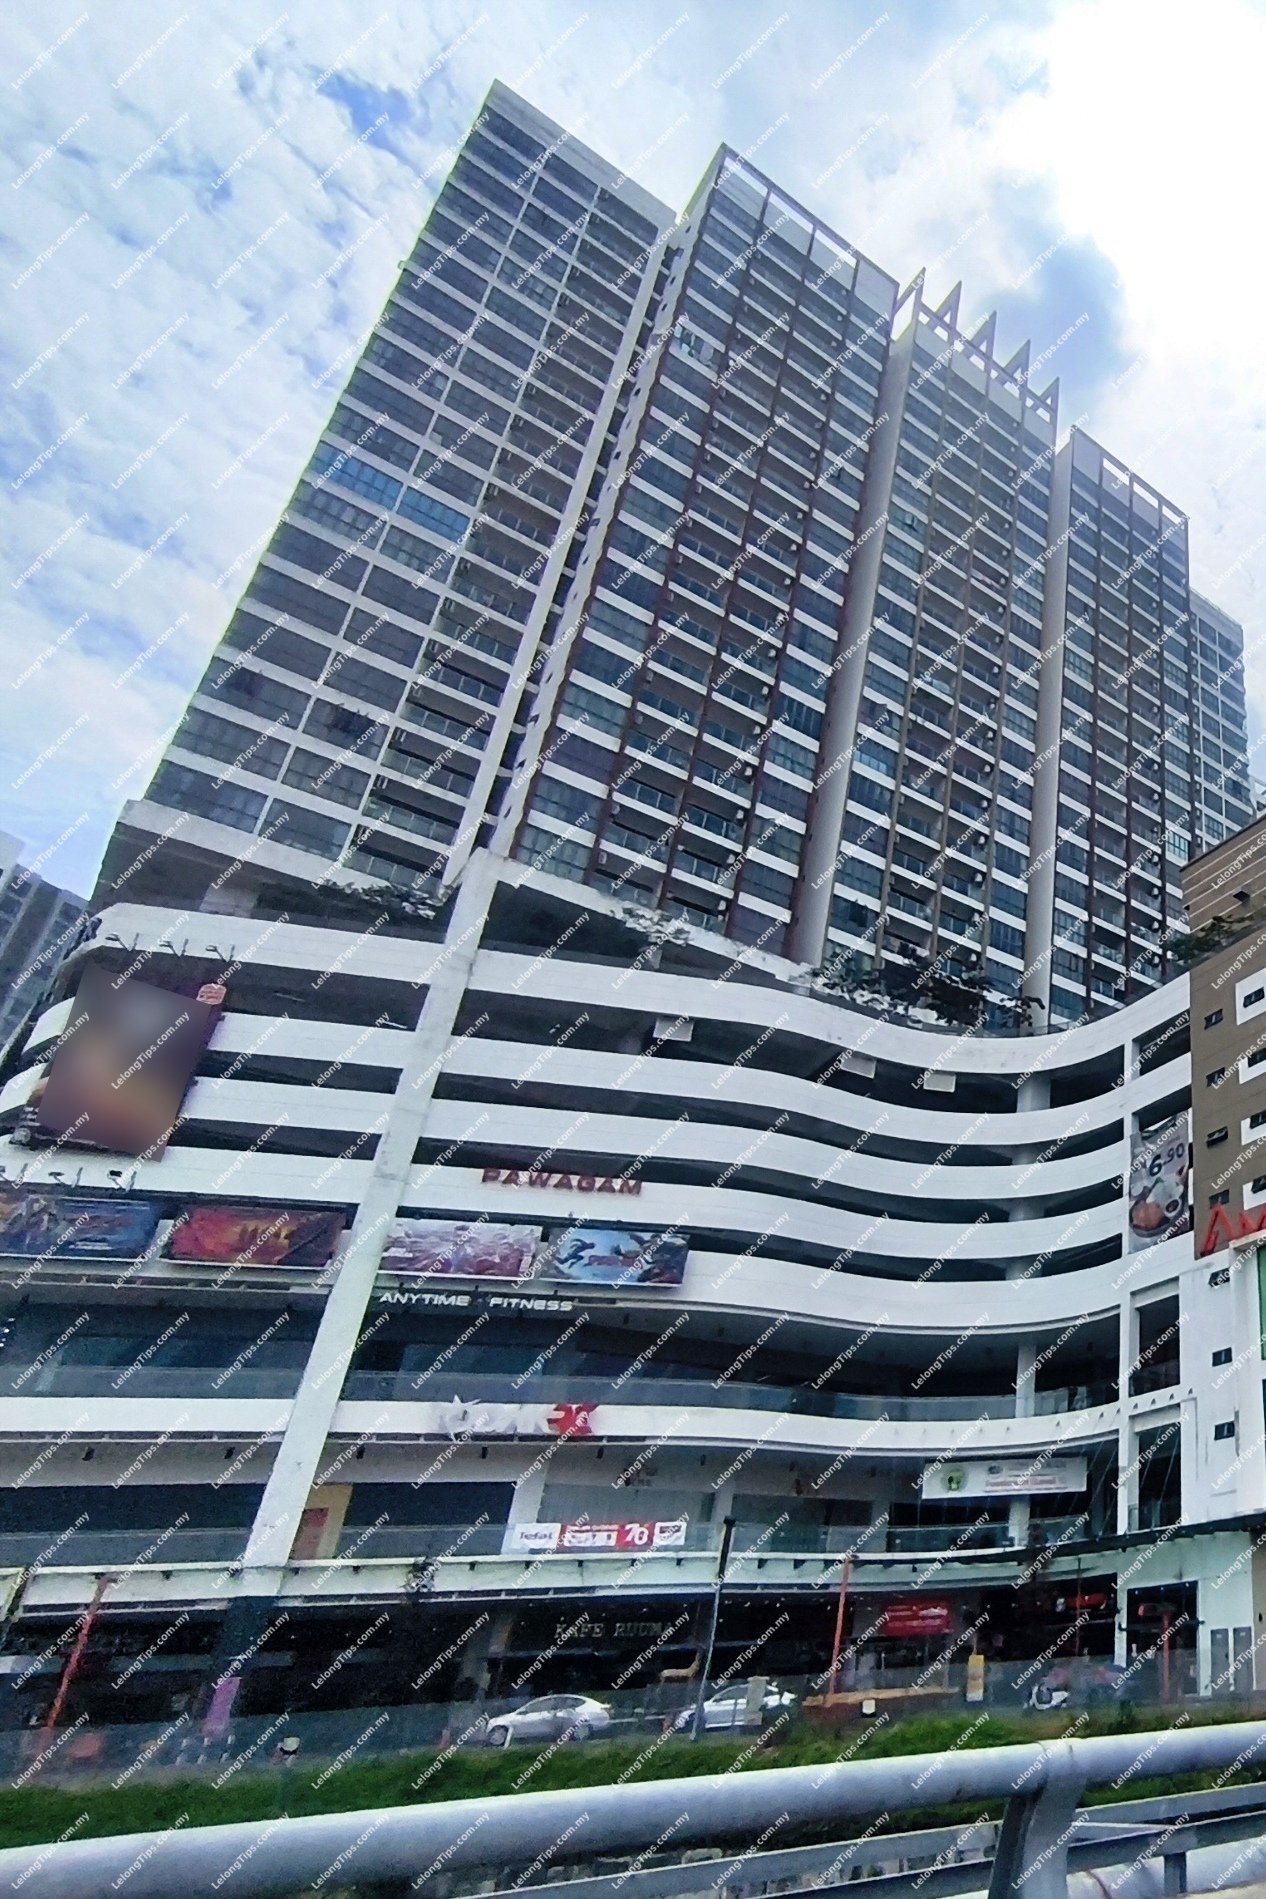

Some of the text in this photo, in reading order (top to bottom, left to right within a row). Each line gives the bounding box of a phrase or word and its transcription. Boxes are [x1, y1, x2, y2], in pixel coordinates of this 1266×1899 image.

[482, 1167, 644, 1196] PAWAGAM
[379, 1291, 574, 1312] ANYTIME FITNESS
[520, 1531, 553, 1541] Tefal
